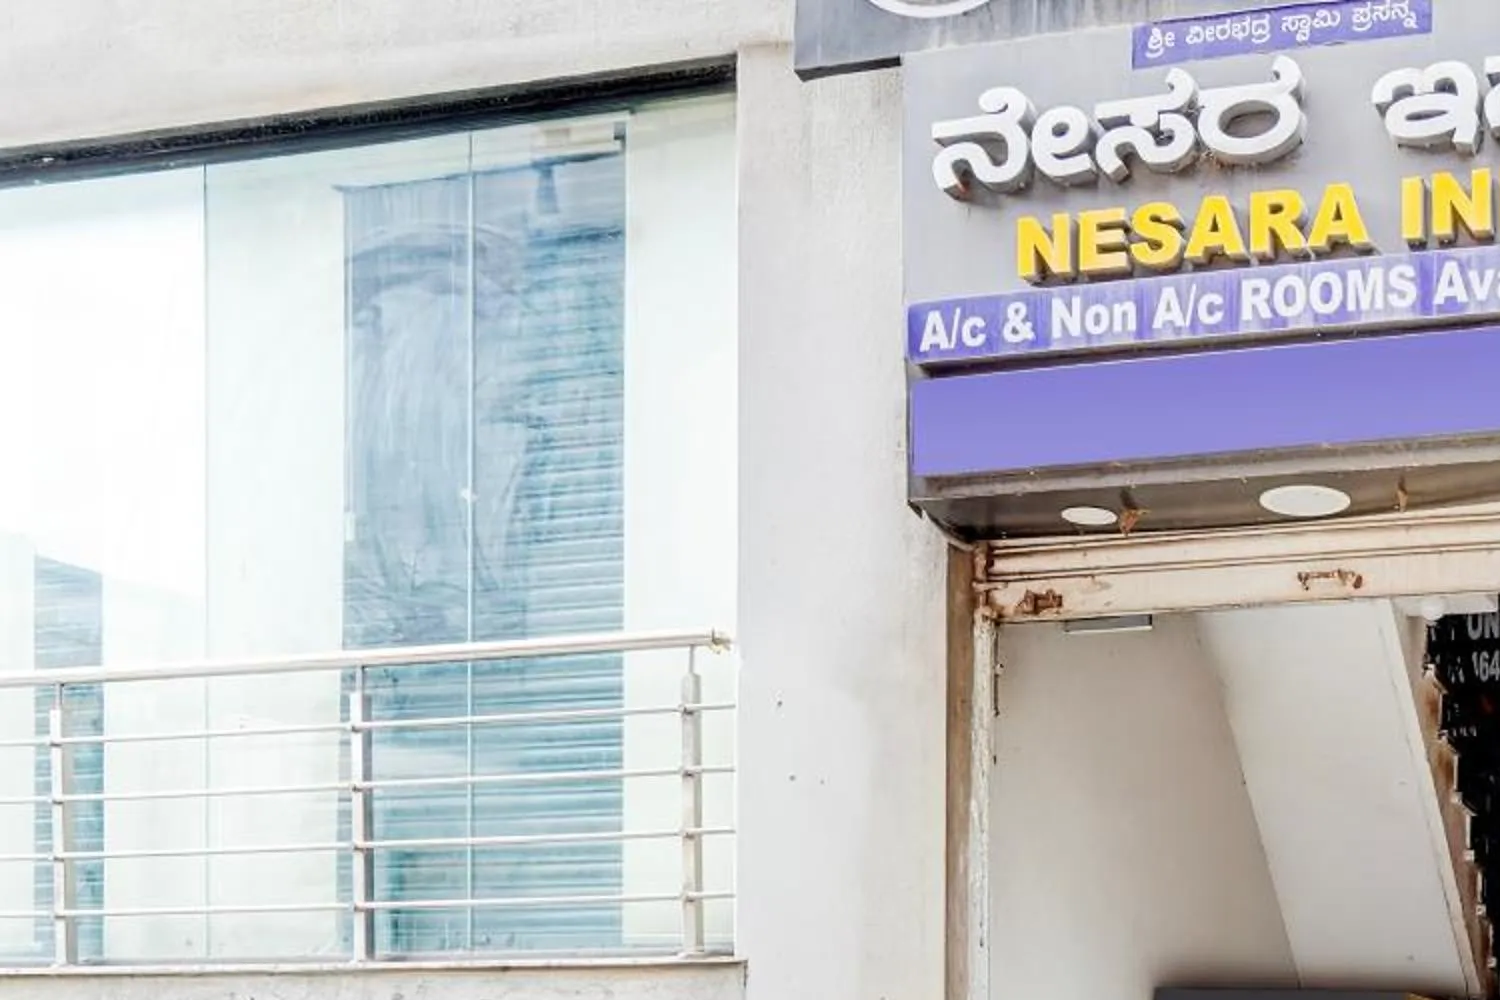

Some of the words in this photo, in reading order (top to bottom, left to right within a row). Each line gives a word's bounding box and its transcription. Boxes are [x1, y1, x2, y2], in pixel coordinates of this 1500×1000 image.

[1145, 27, 1175, 57] ಶ್ರೀ
[1186, 14, 1271, 44] ವೀರಭದ್ರ
[1280, 8, 1340, 42] ಸ್ವಾಮಿ
[931, 55, 1307, 197] ನೇಸರ
[1016, 182, 1372, 282] NESARA
[919, 307, 986, 352] A/c
[1002, 301, 1035, 343] &
[1051, 296, 1136, 339] Non
[1152, 281, 1224, 328] A/c
[1241, 264, 1417, 321] ROOMS
